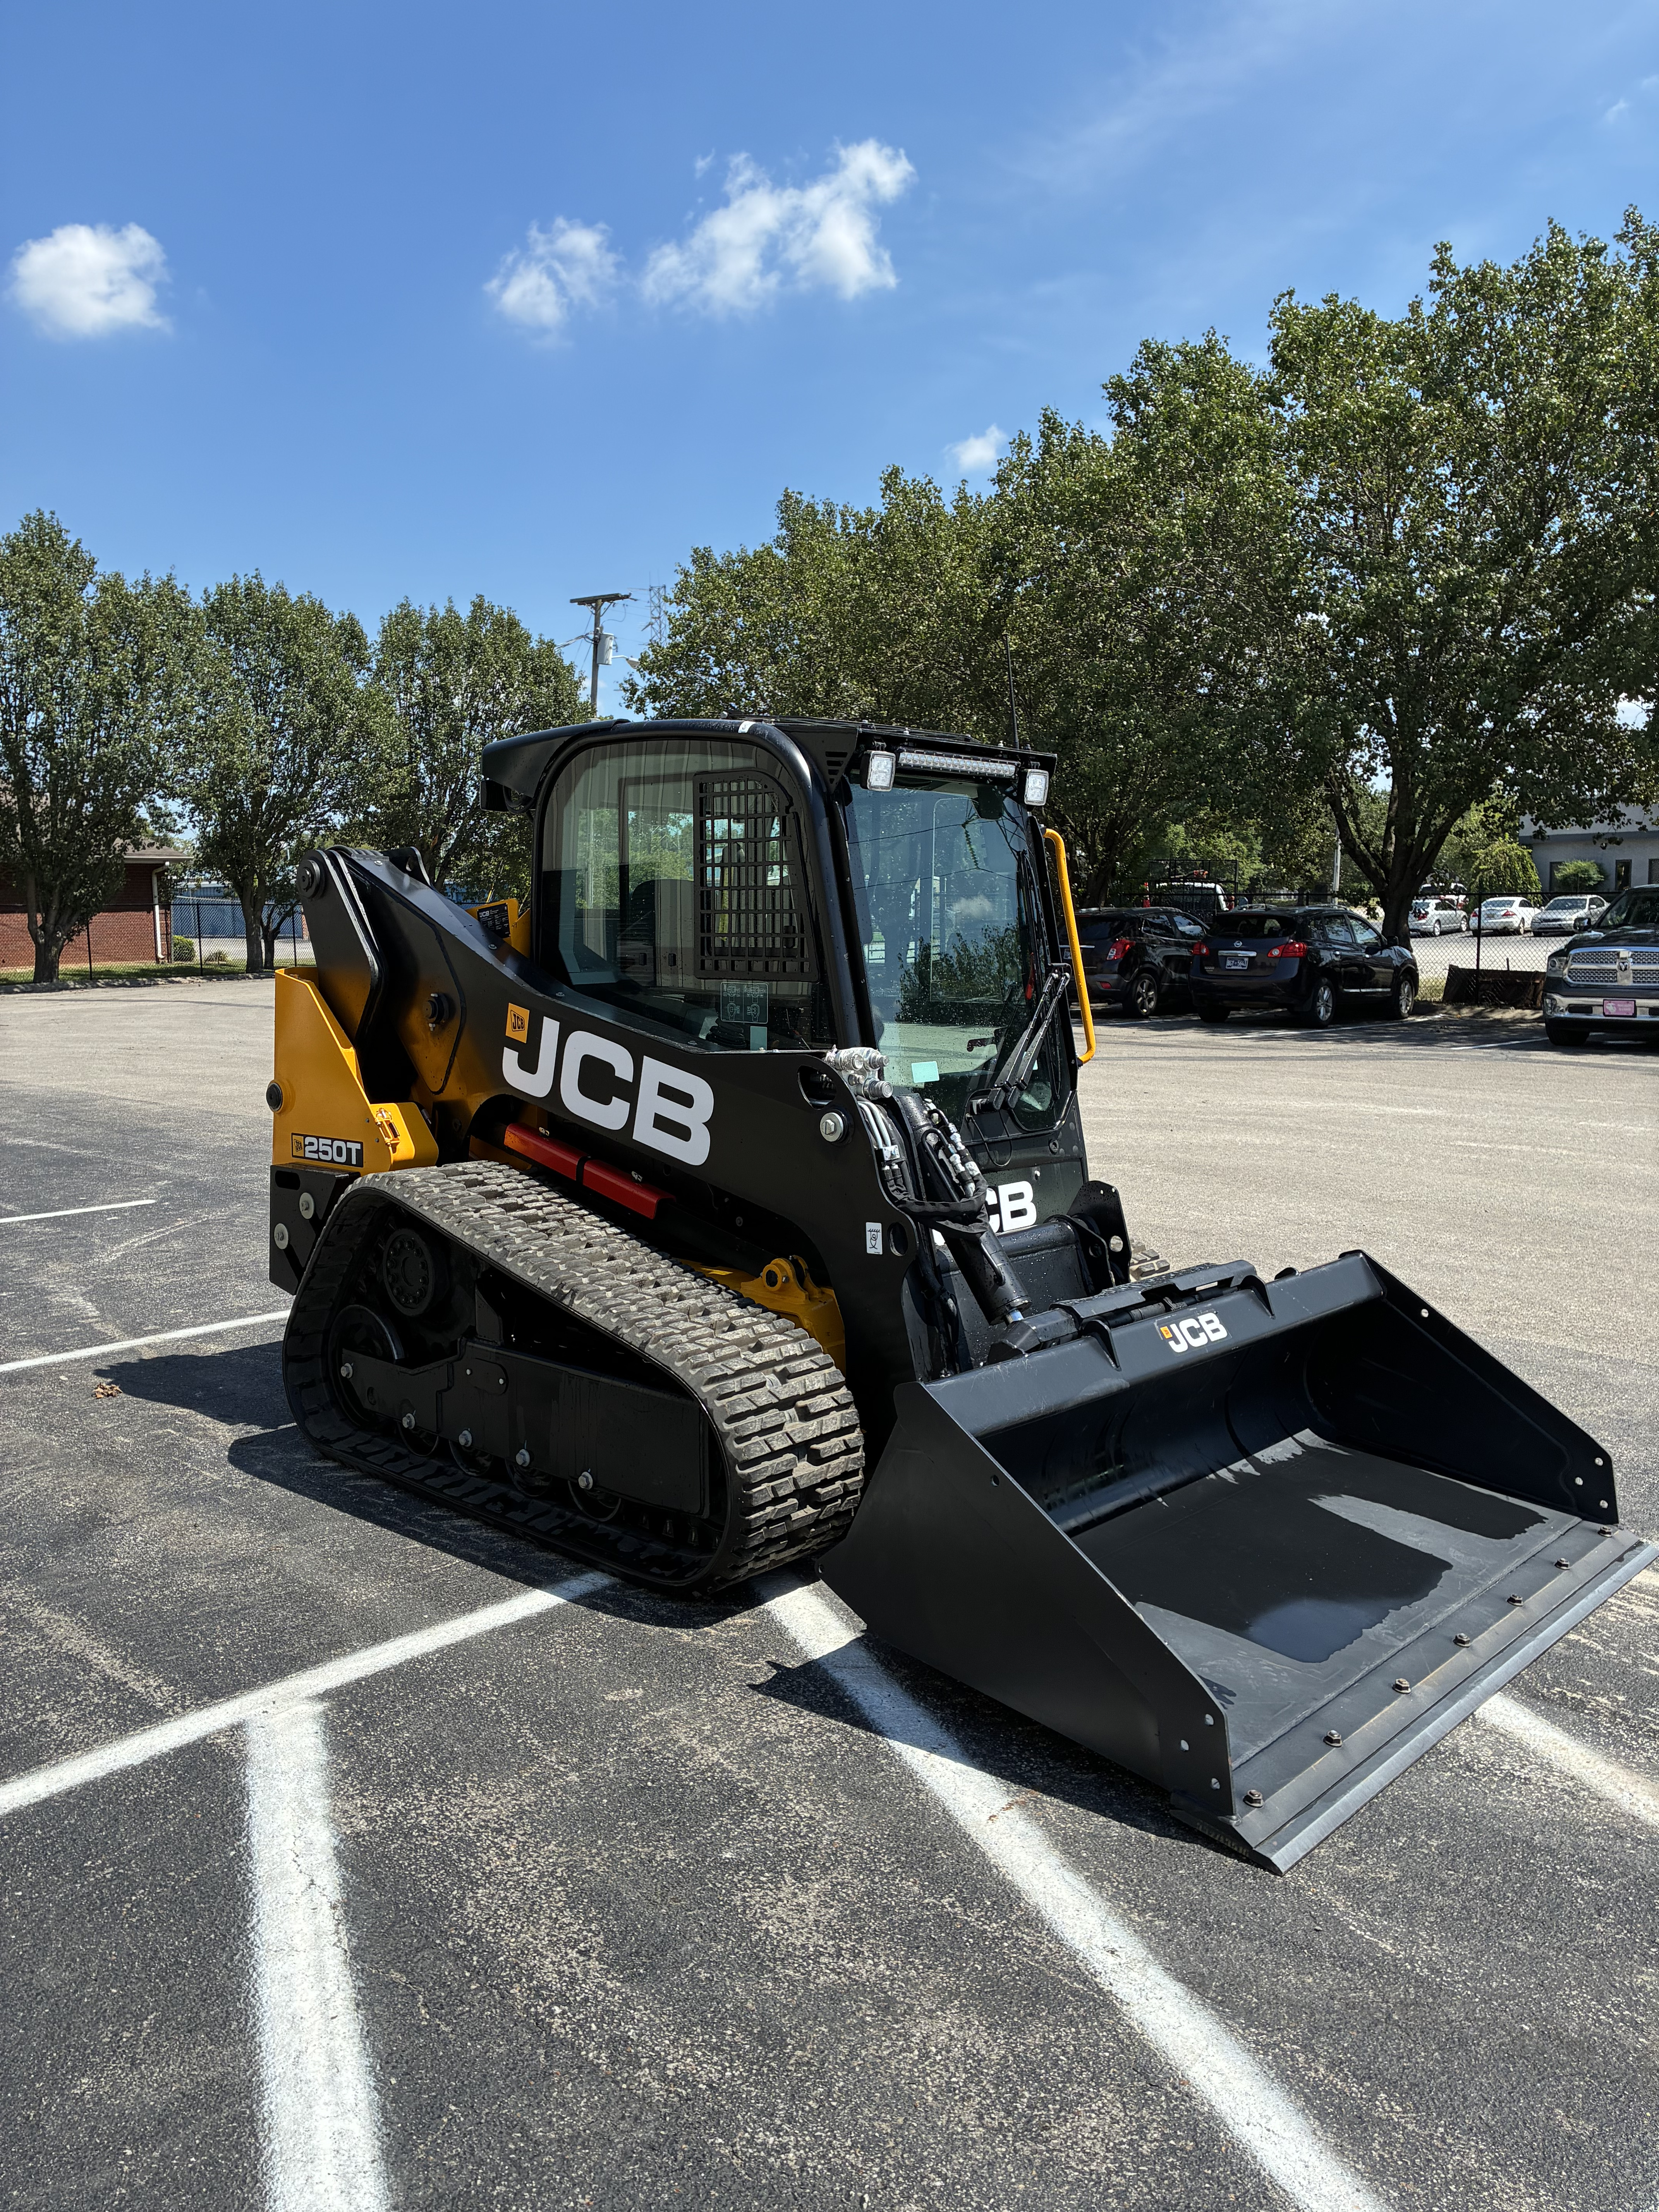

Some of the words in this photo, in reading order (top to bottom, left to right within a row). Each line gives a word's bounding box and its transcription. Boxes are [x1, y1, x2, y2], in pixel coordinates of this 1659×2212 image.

[513, 1013, 524, 1029] JCB
[502, 1016, 714, 1166] JCB
[305, 1137, 361, 1164] 250T
[1168, 1312, 1228, 1353] JCB
